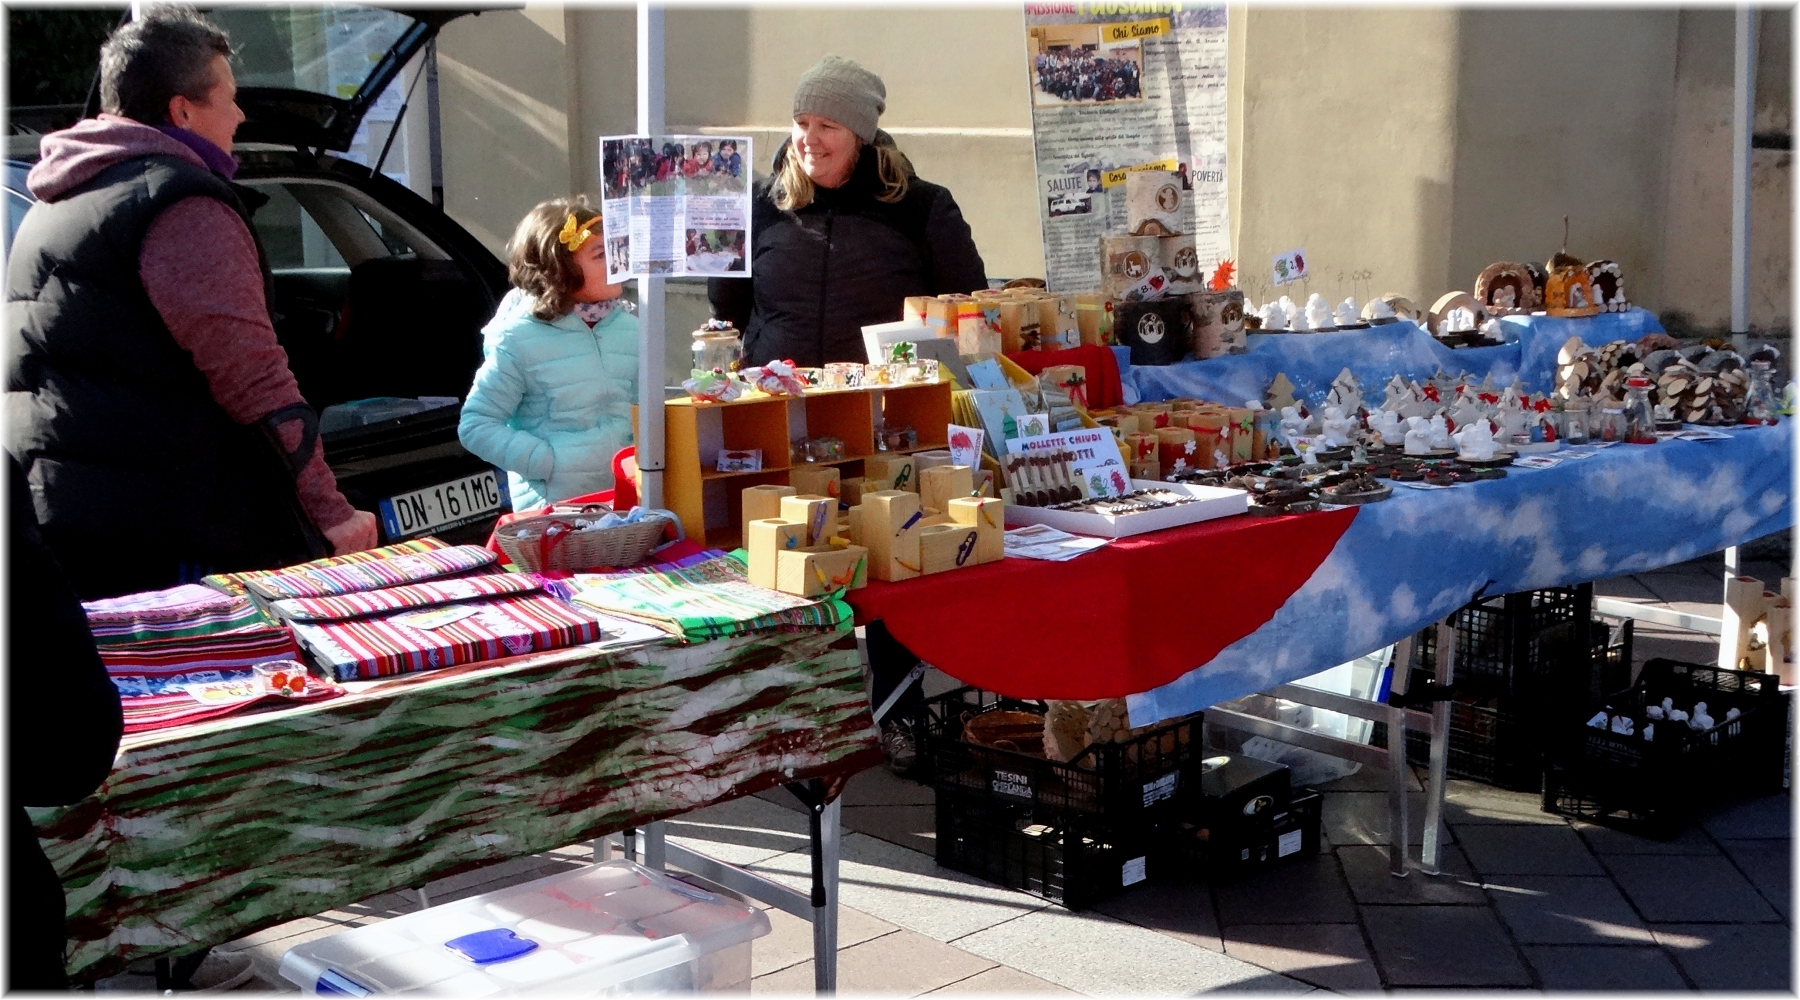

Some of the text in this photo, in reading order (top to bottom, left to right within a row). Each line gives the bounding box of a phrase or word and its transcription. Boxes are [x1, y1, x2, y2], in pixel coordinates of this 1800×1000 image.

[1112, 24, 1160, 39] Chi Siamo
[1047, 176, 1082, 193] SALUTE
[1021, 433, 1102, 451] MOLLETTE CHIUDI
[994, 770, 1028, 785] TESINI
